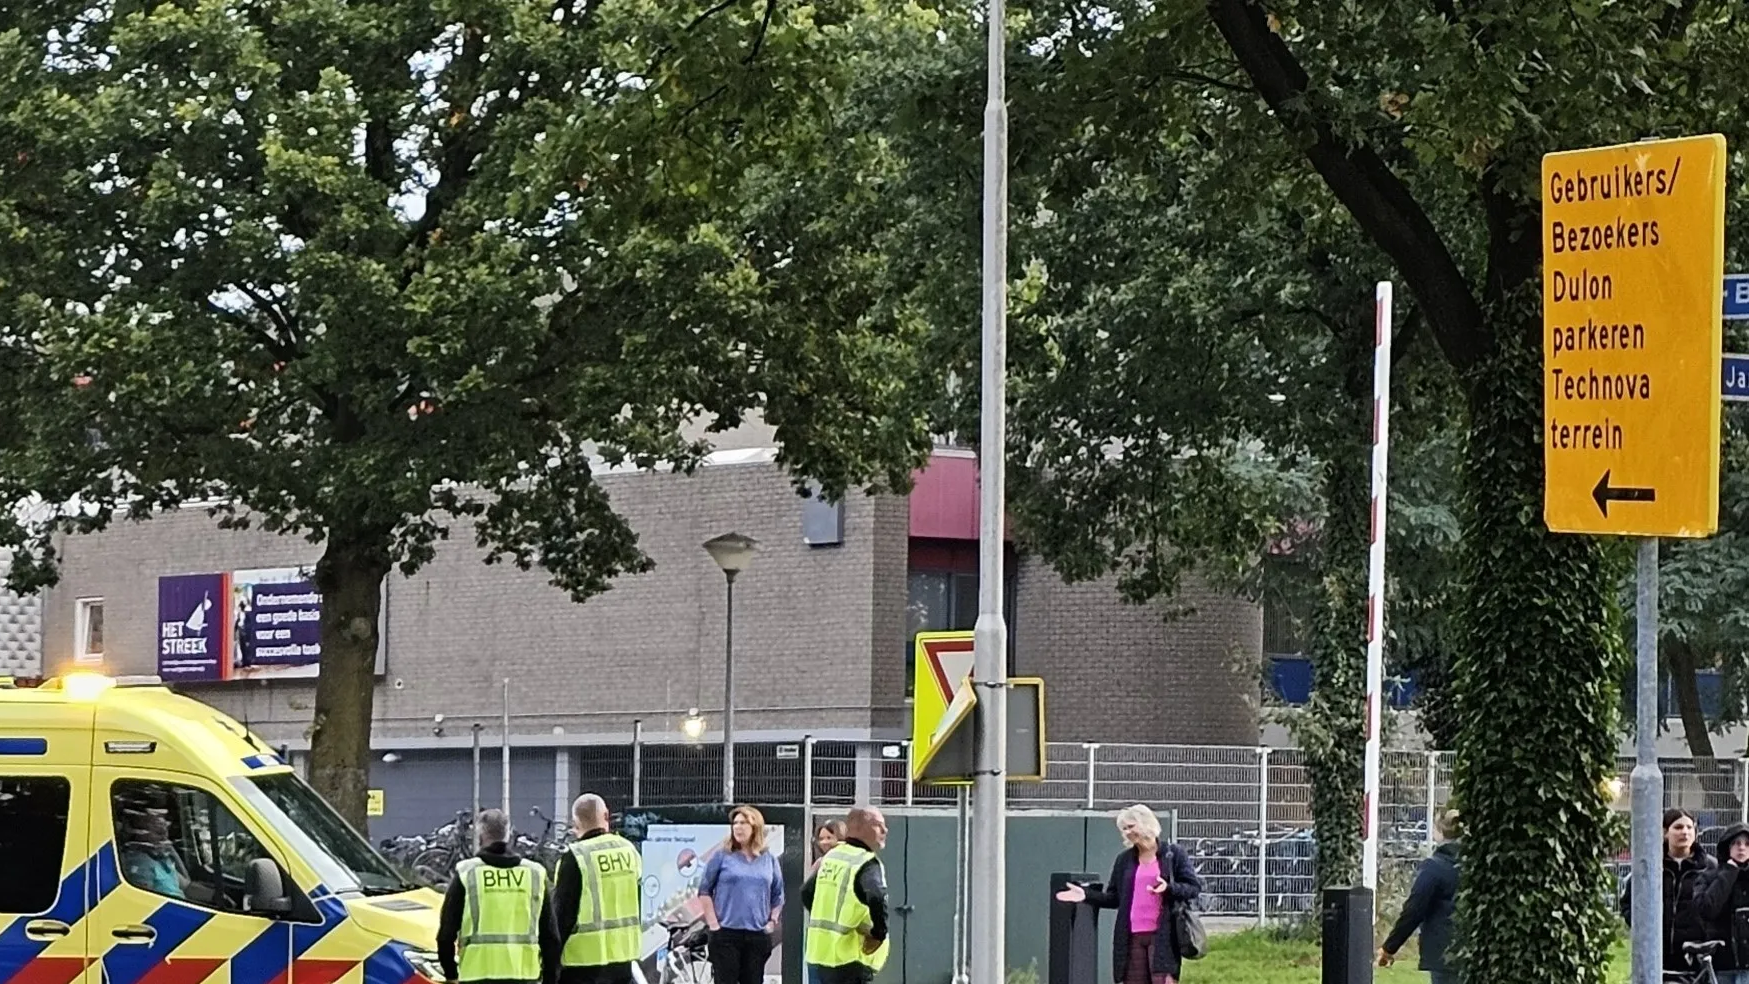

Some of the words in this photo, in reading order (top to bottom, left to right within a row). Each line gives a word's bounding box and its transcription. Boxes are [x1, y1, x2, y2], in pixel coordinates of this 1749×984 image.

[1550, 156, 1681, 204] Gebruikers/
[1552, 216, 1660, 253] Bezoekers
[1552, 268, 1612, 302] Dulon
[1552, 318, 1644, 359] parkeren
[1552, 367, 1650, 400] Technova
[1726, 366, 1749, 390] Ja
[1551, 418, 1622, 449] terrein
[162, 621, 185, 638] HET
[162, 637, 208, 655] STREEK
[483, 869, 525, 887] BHV
[597, 852, 632, 873] BHV
